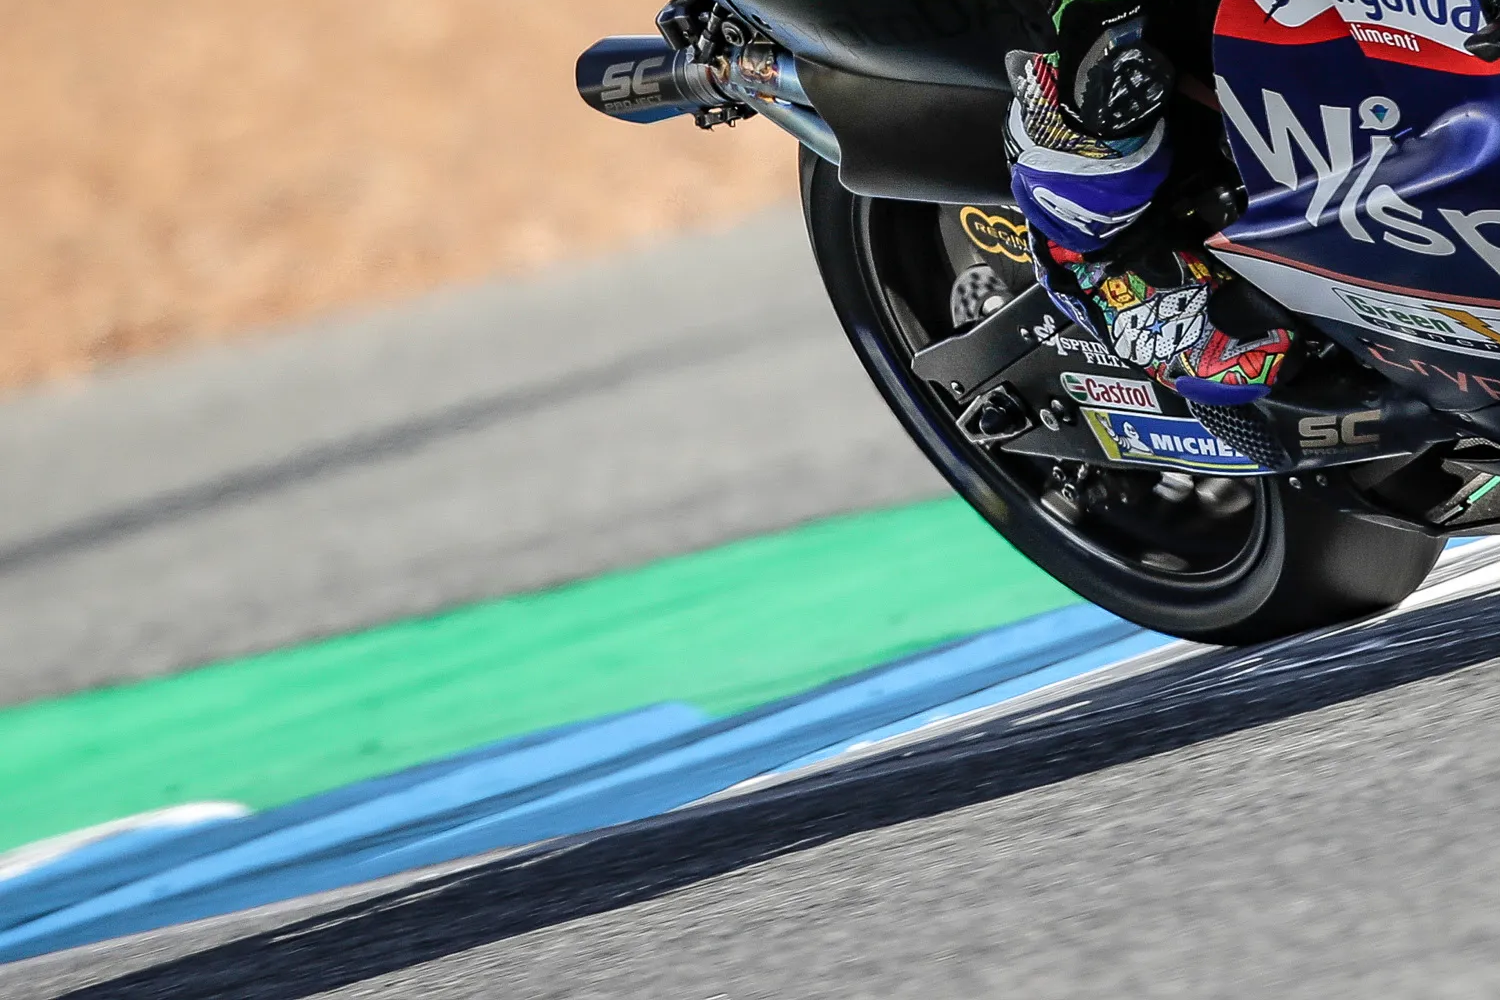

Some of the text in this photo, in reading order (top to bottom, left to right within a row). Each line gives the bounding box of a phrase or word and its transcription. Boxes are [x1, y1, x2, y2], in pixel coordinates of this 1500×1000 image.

[1349, 23, 1420, 53] limenti
[601, 56, 665, 101] SC
[974, 221, 1028, 249] REGIN
[1346, 294, 1457, 335] Green
[1062, 337, 1110, 356] SPRIN
[1084, 351, 1131, 370] FILT
[1084, 377, 1156, 409] Castrol
[1298, 409, 1382, 449] SC
[1149, 432, 1244, 459] MICHE
